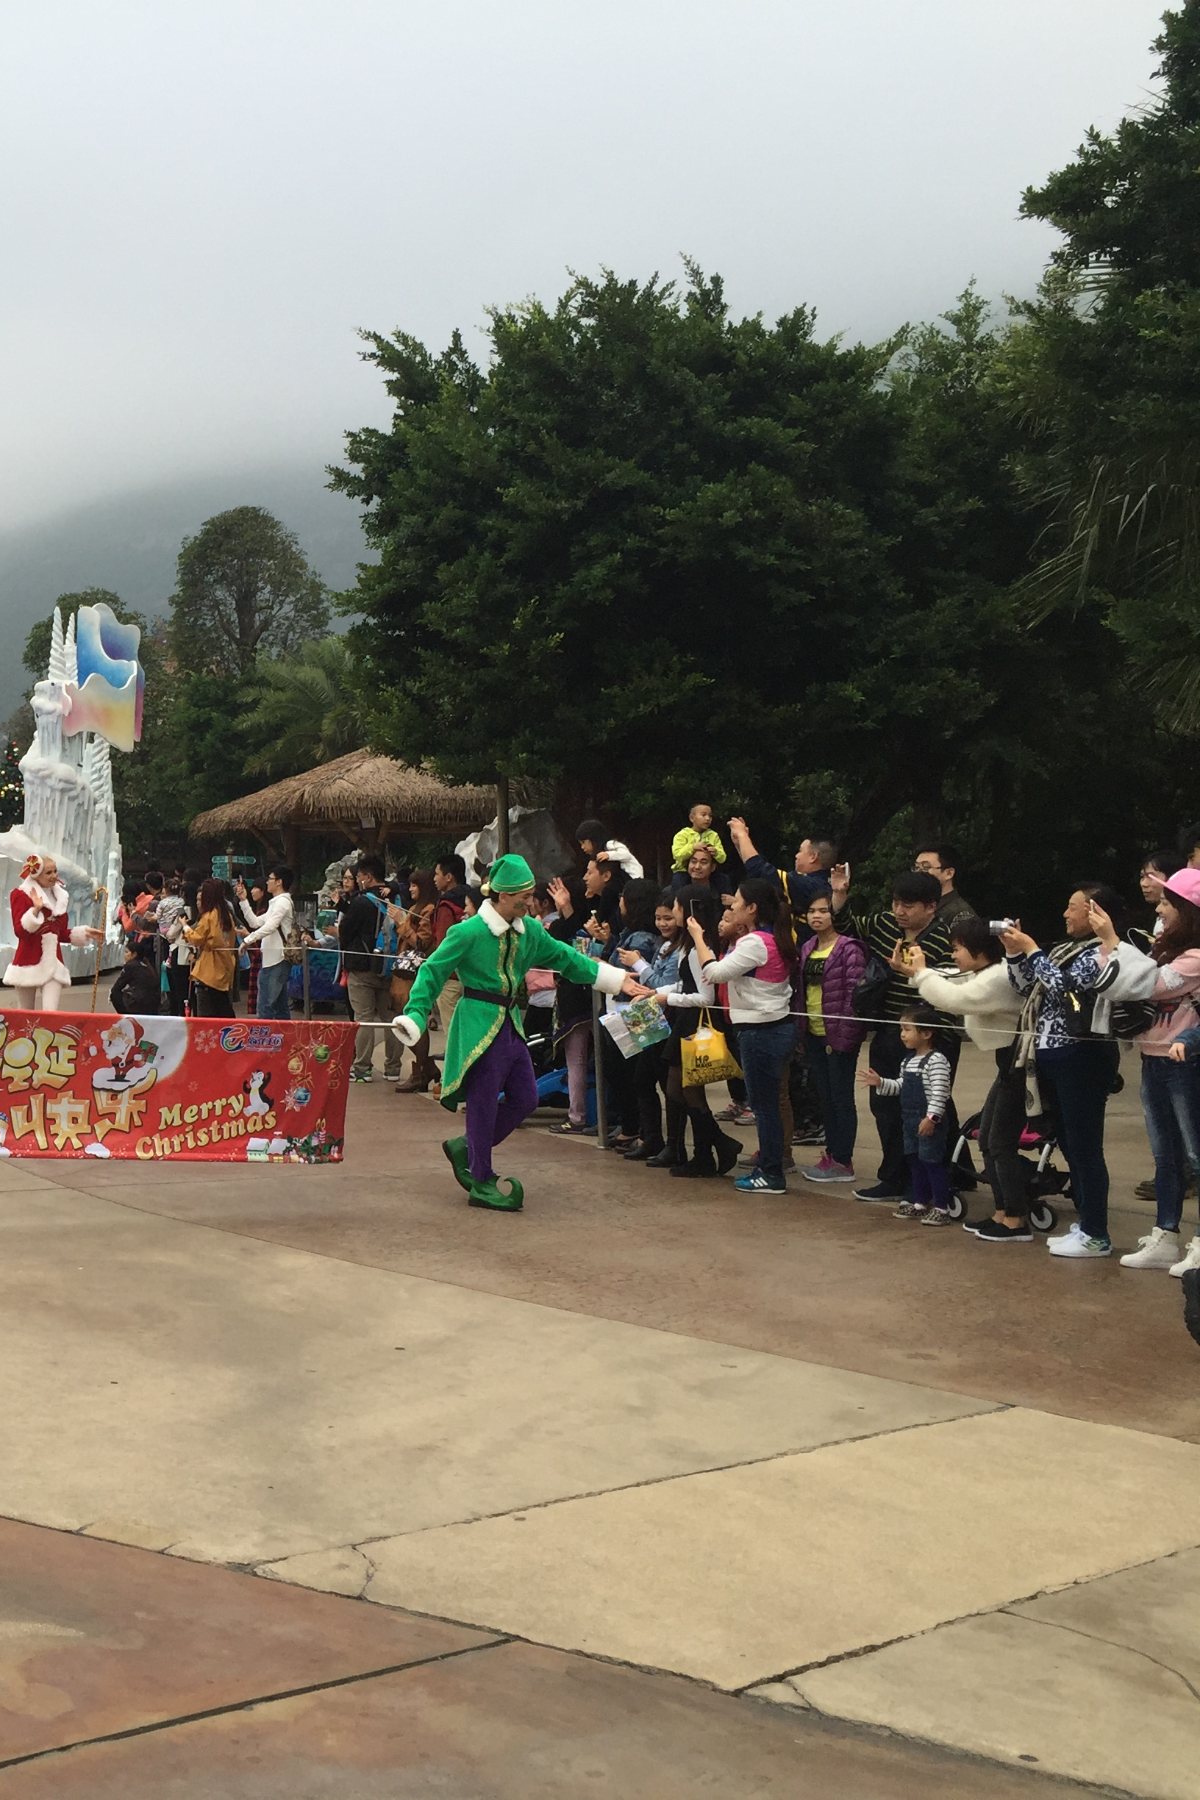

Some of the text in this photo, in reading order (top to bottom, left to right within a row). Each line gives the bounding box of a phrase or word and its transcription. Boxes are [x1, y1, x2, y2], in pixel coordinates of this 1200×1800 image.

[10, 1067, 158, 1150] 快乐
[158, 1093, 244, 1130] Merry
[135, 1110, 277, 1160] Christmas
